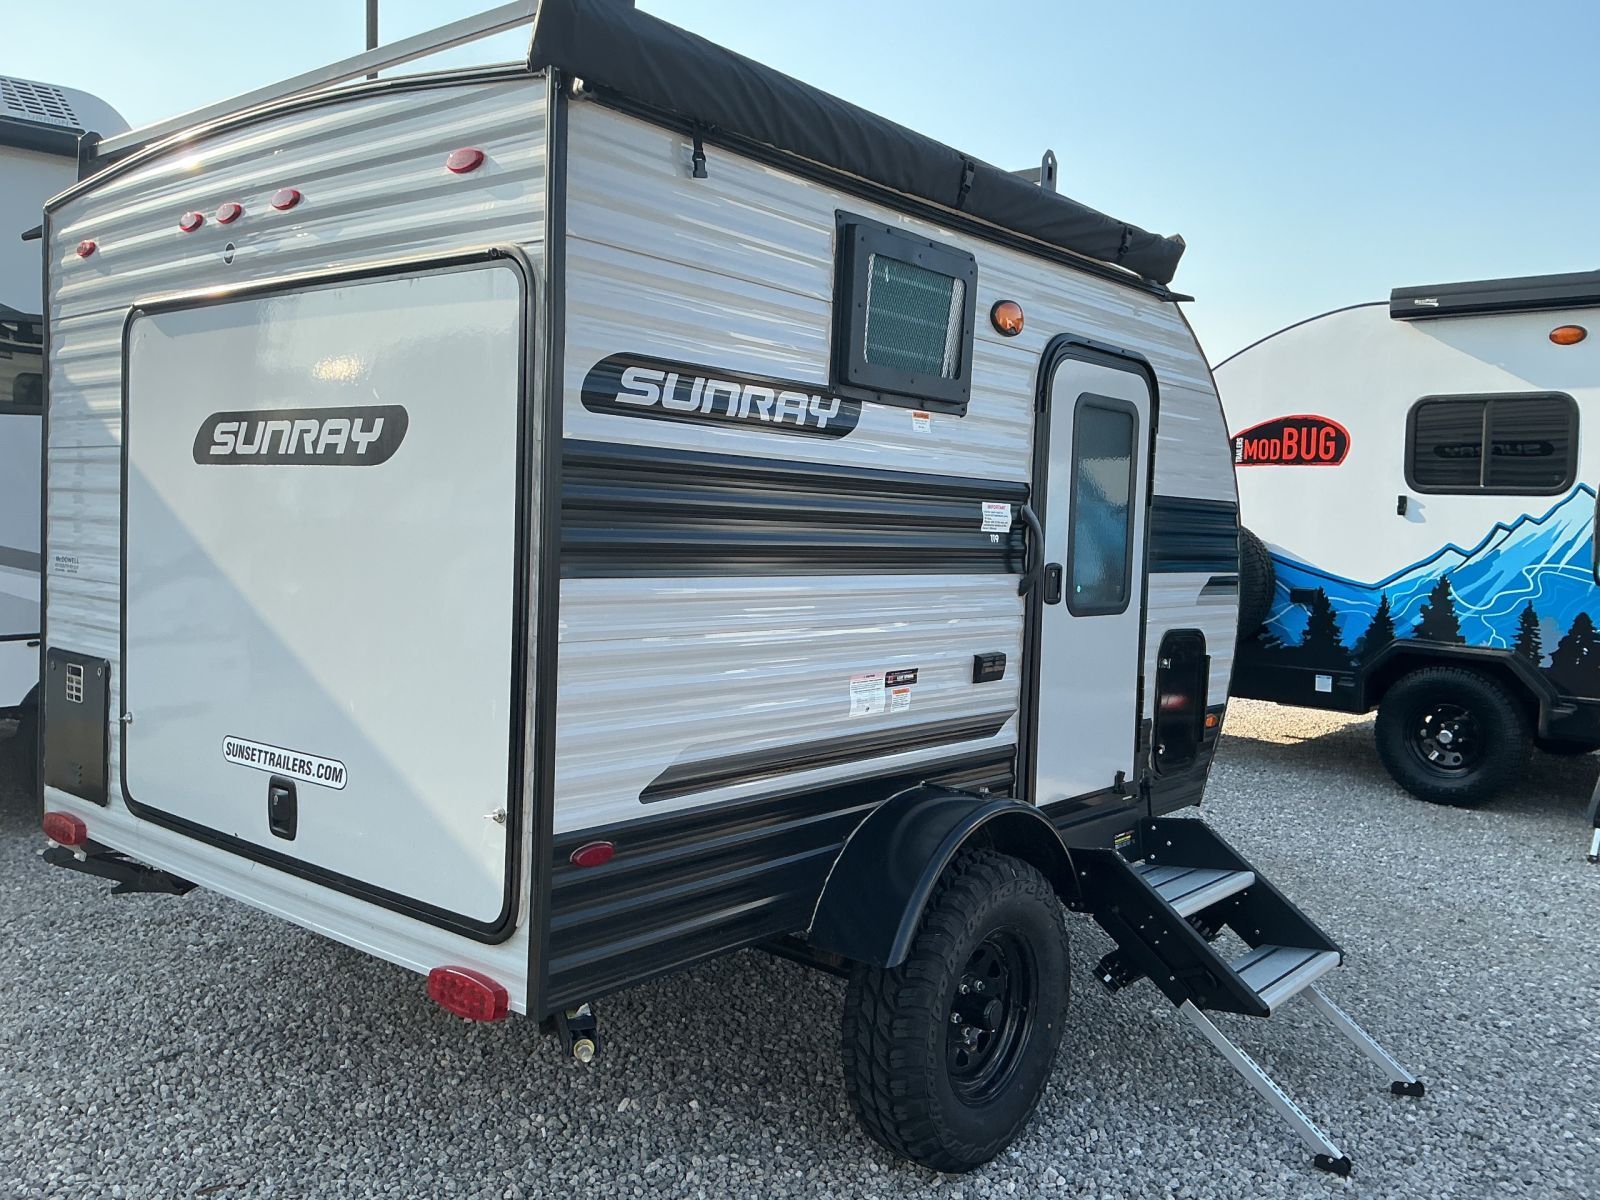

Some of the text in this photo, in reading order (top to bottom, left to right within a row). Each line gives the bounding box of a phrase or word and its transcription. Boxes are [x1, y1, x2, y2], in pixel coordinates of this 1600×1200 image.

[615, 366, 841, 428] SUNRAY
[209, 417, 385, 455] SUNRAY
[225, 741, 344, 784] SUNSETTRAILERS.COM
